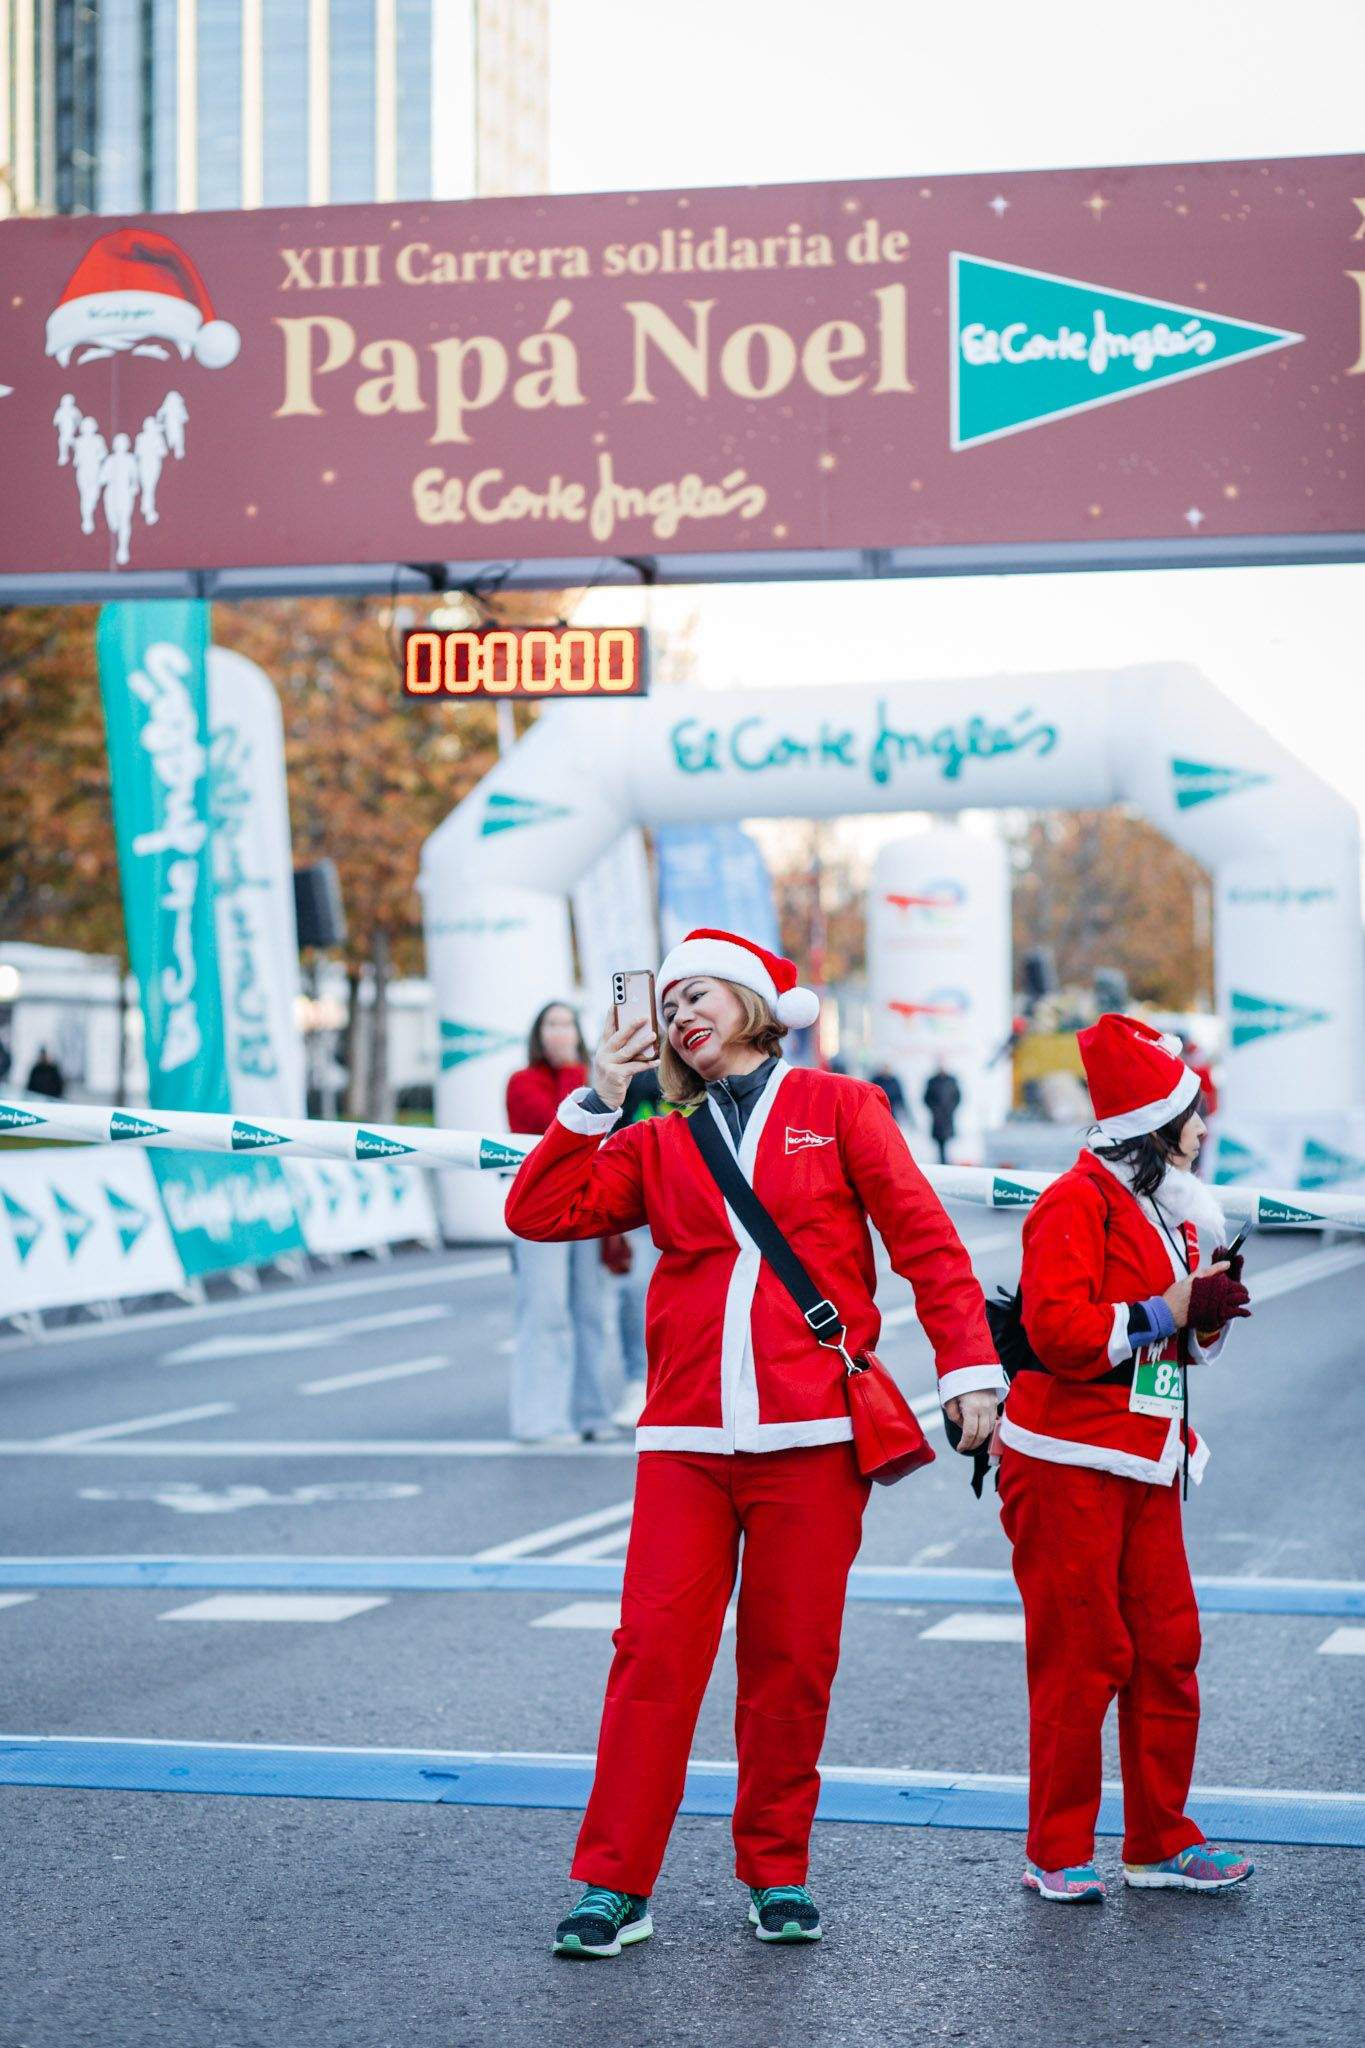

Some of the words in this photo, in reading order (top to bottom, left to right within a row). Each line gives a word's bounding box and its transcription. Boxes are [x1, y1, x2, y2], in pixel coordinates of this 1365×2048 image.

[279, 244, 384, 291] XIII
[395, 242, 591, 285] Carrera
[603, 223, 836, 276] solidaria
[846, 218, 910, 264] de
[272, 297, 590, 445] Papá
[623, 283, 918, 404] Noel
[961, 323, 1000, 366] El
[1000, 322, 1088, 364] Corte
[1088, 309, 1216, 375] Inglés
[412, 467, 466, 524] El
[467, 467, 587, 524] Corte
[590, 452, 767, 541] Inglés
[407, 630, 634, 694] 00:00:00
[671, 717, 722, 773] El
[731, 716, 855, 771] Corte
[869, 699, 1057, 785] Inglés
